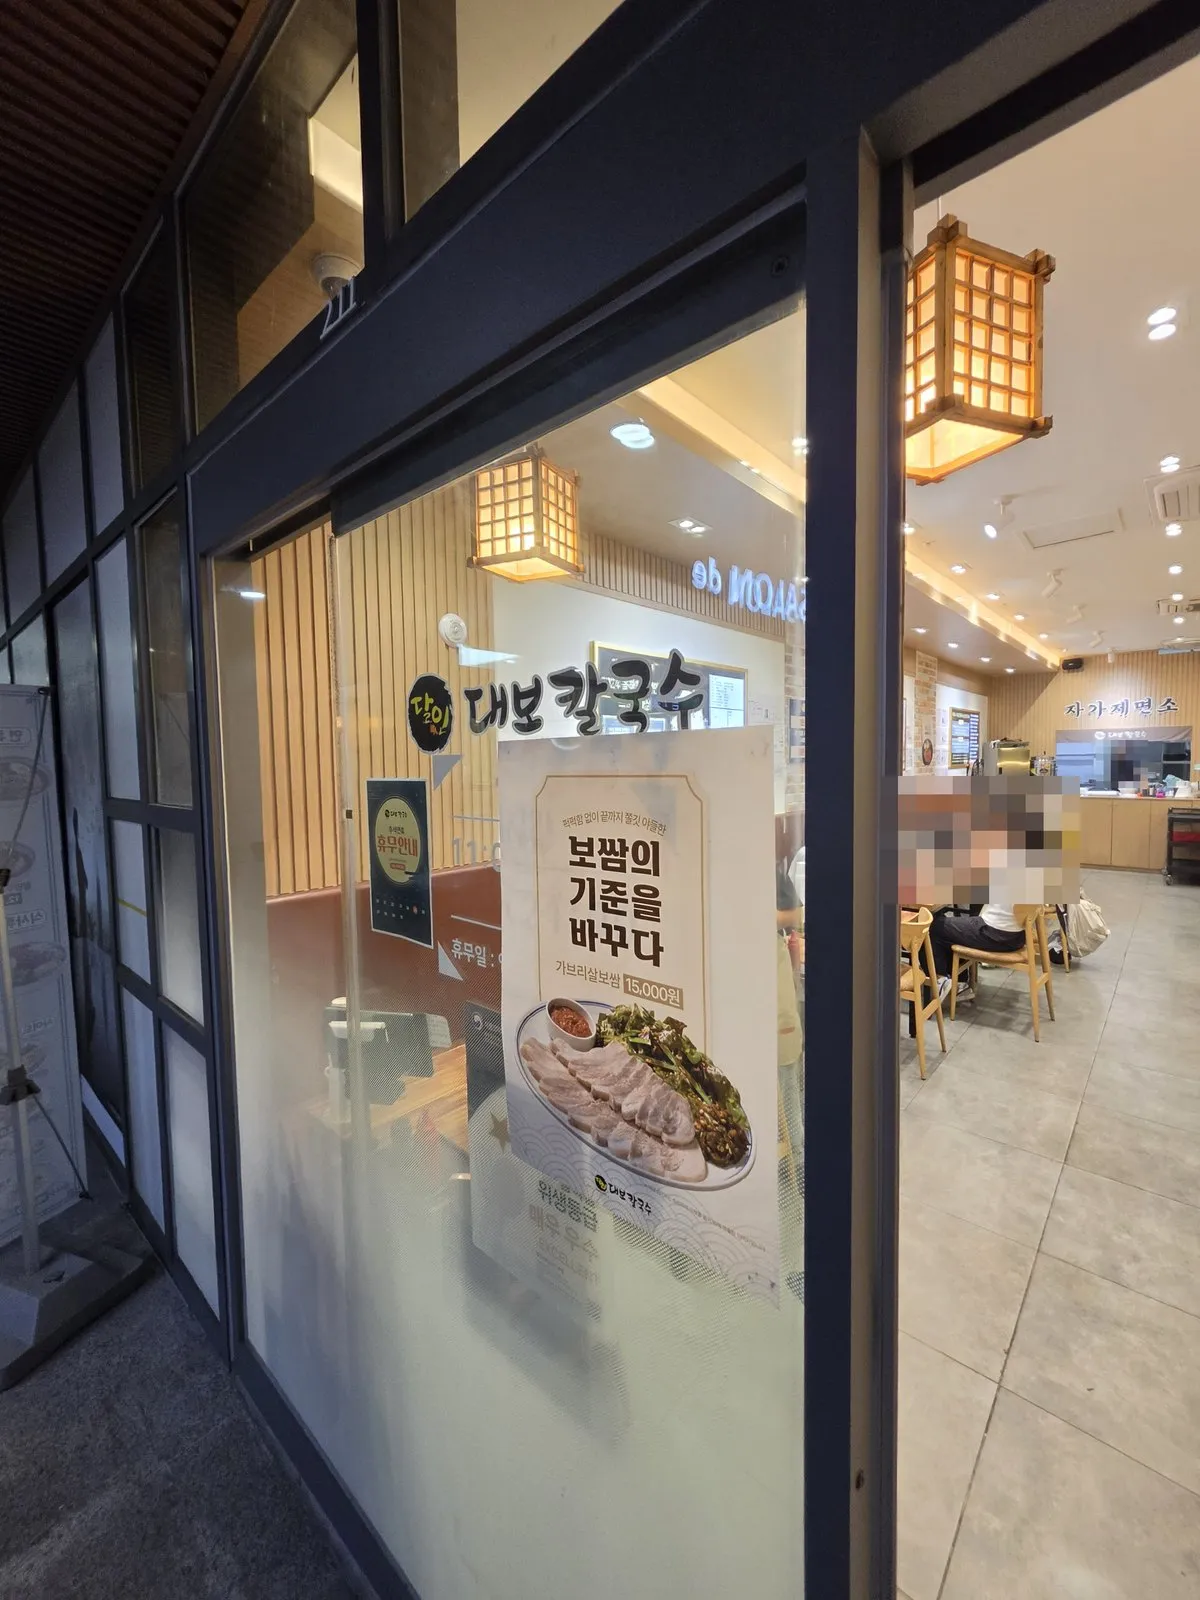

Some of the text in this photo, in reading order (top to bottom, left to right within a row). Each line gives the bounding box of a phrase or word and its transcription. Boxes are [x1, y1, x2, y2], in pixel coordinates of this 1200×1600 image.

[463, 649, 704, 736] 대보칼국수
[1064, 697, 1178, 718] 자가제면소
[584, 811, 599, 824] 없이
[600, 810, 623, 823] 끝까지
[377, 834, 418, 857] 휴무안내
[568, 836, 660, 876] 보쌈의
[569, 877, 662, 923] 기준을
[452, 938, 487, 968] 휴무일
[569, 917, 664, 968] 바꾸다
[556, 960, 680, 1006] 가브리살보쌈 15,000원
[608, 1182, 651, 1216] 대보칼국수
